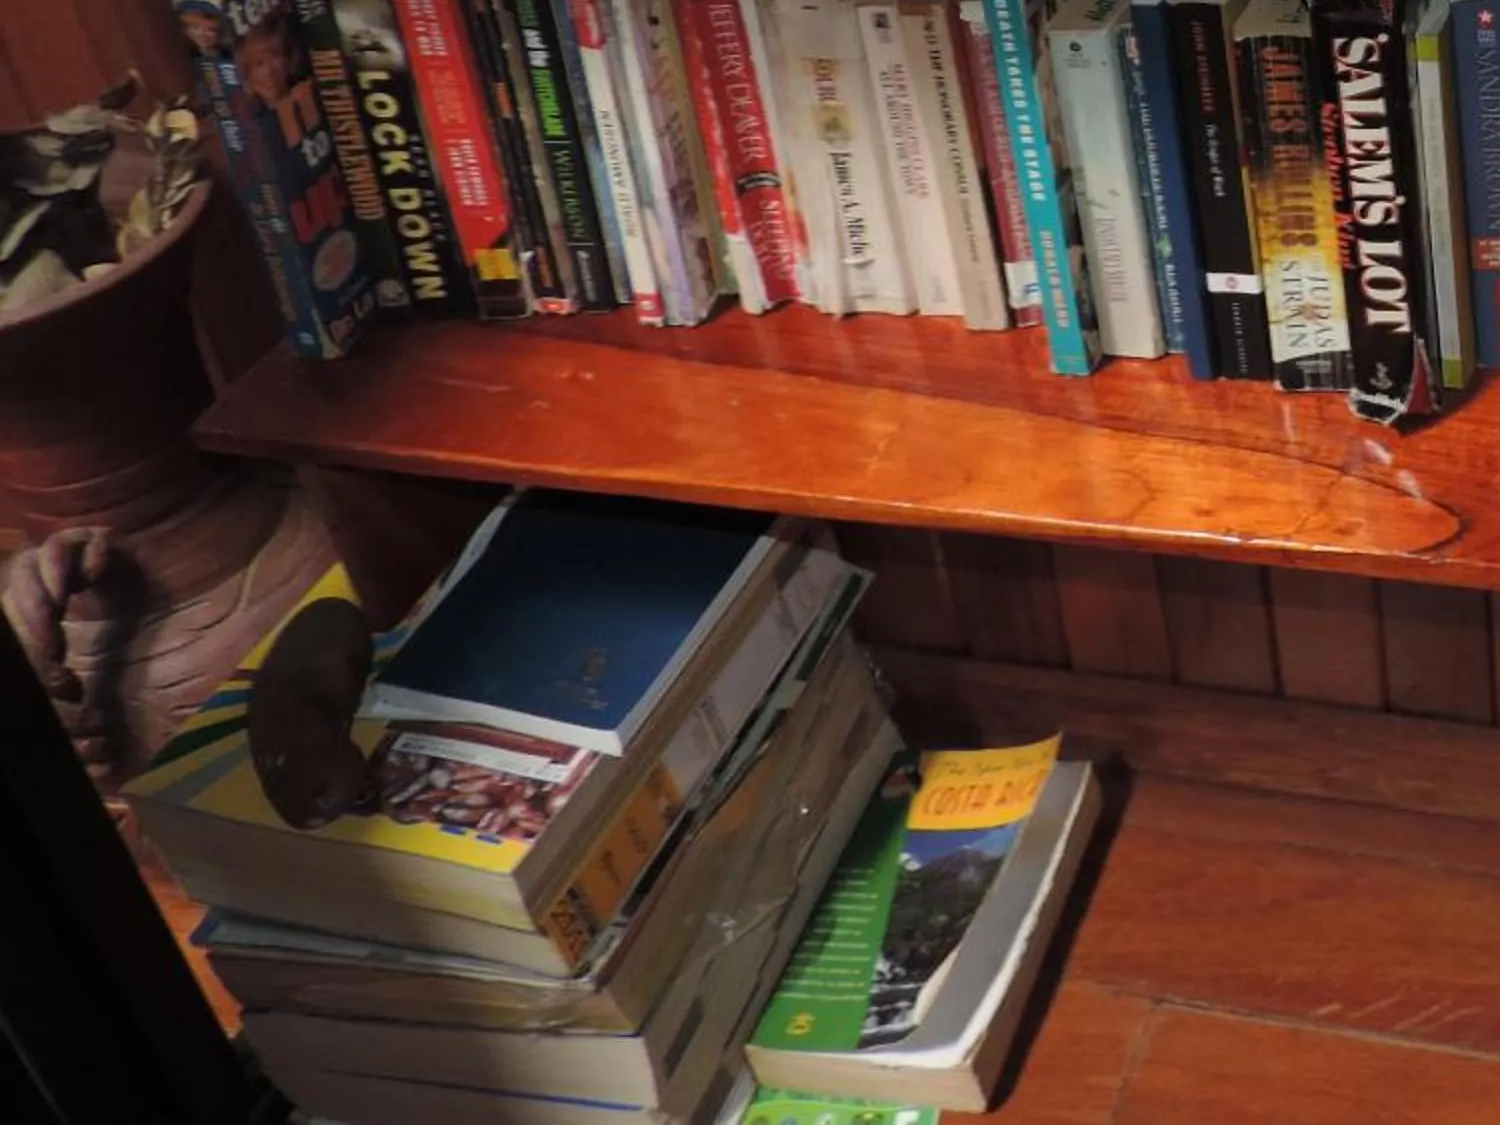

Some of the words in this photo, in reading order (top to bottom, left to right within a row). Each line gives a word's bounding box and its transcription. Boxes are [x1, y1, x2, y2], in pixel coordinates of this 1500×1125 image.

[706, 0, 749, 82] JEFFERY
[352, 63, 417, 179] LOCK
[724, 78, 769, 165] DEAVER
[1257, 43, 1309, 136] JAMES
[1268, 140, 1321, 250] ROLLINS
[383, 180, 452, 305] DOWN
[1353, 233, 1416, 337] LOT
[1277, 259, 1309, 349] STRAIN
[1306, 272, 1335, 349] JUDAS
